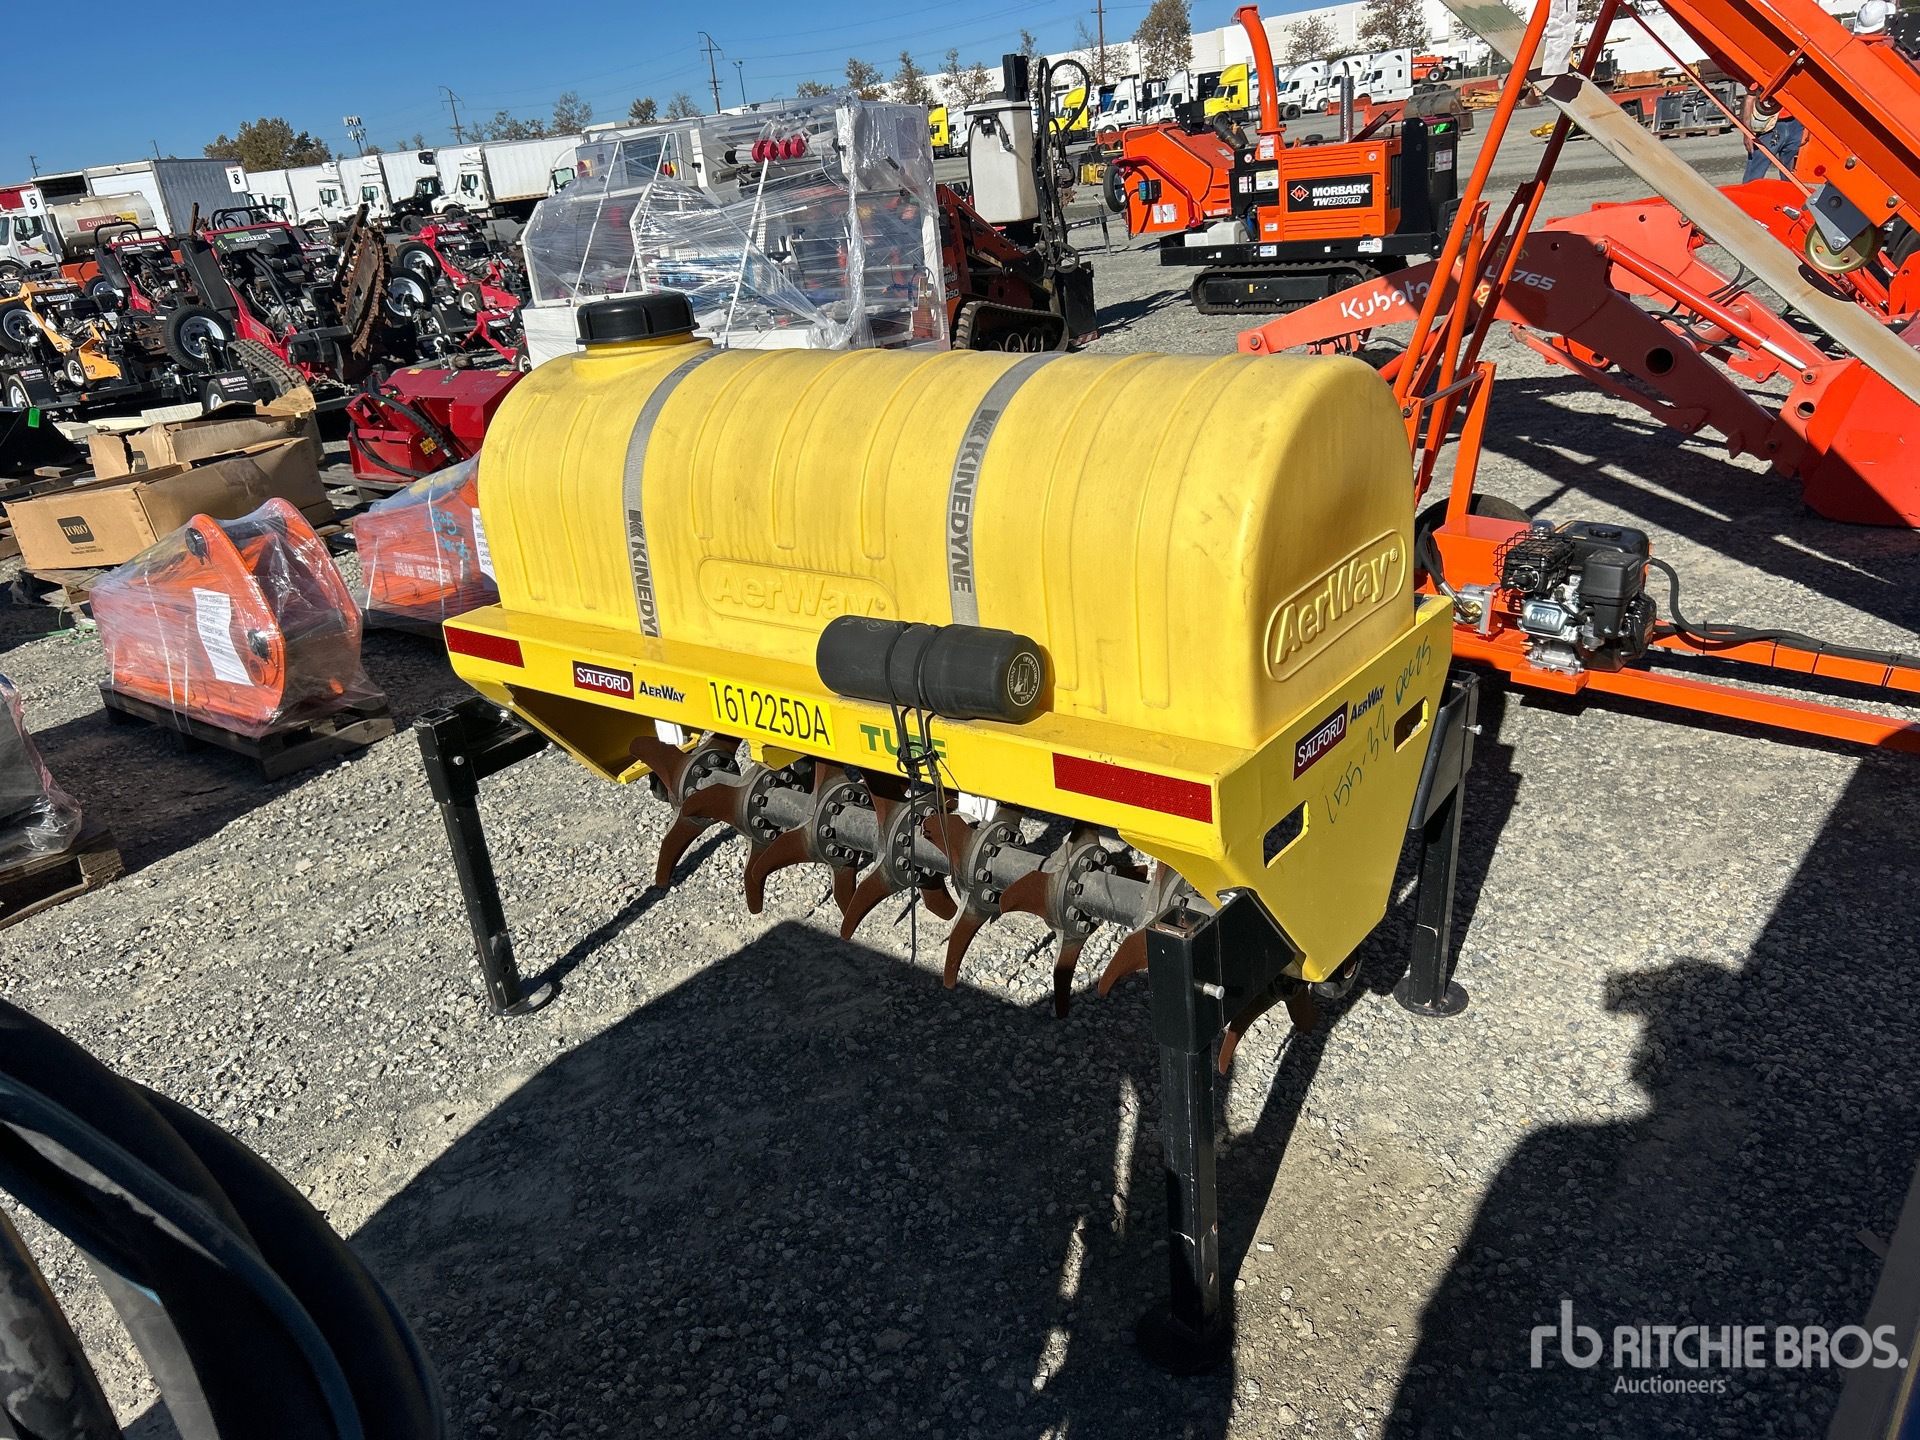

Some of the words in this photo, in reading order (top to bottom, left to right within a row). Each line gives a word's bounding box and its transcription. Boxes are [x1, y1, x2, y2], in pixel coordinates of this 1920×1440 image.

[233, 173, 241, 185] 8
[1312, 183, 1370, 197] MORBARK
[29, 197, 38, 210] 9
[86, 218, 112, 228] QUINN
[1484, 265, 1556, 291] L765
[62, 524, 88, 537] TORO
[950, 441, 985, 594] KINEDYNE
[631, 540, 660, 639] KINEDY
[576, 666, 631, 693] SALFORD
[709, 681, 831, 746] 161225DA
[1297, 713, 1345, 768] SALFORD
